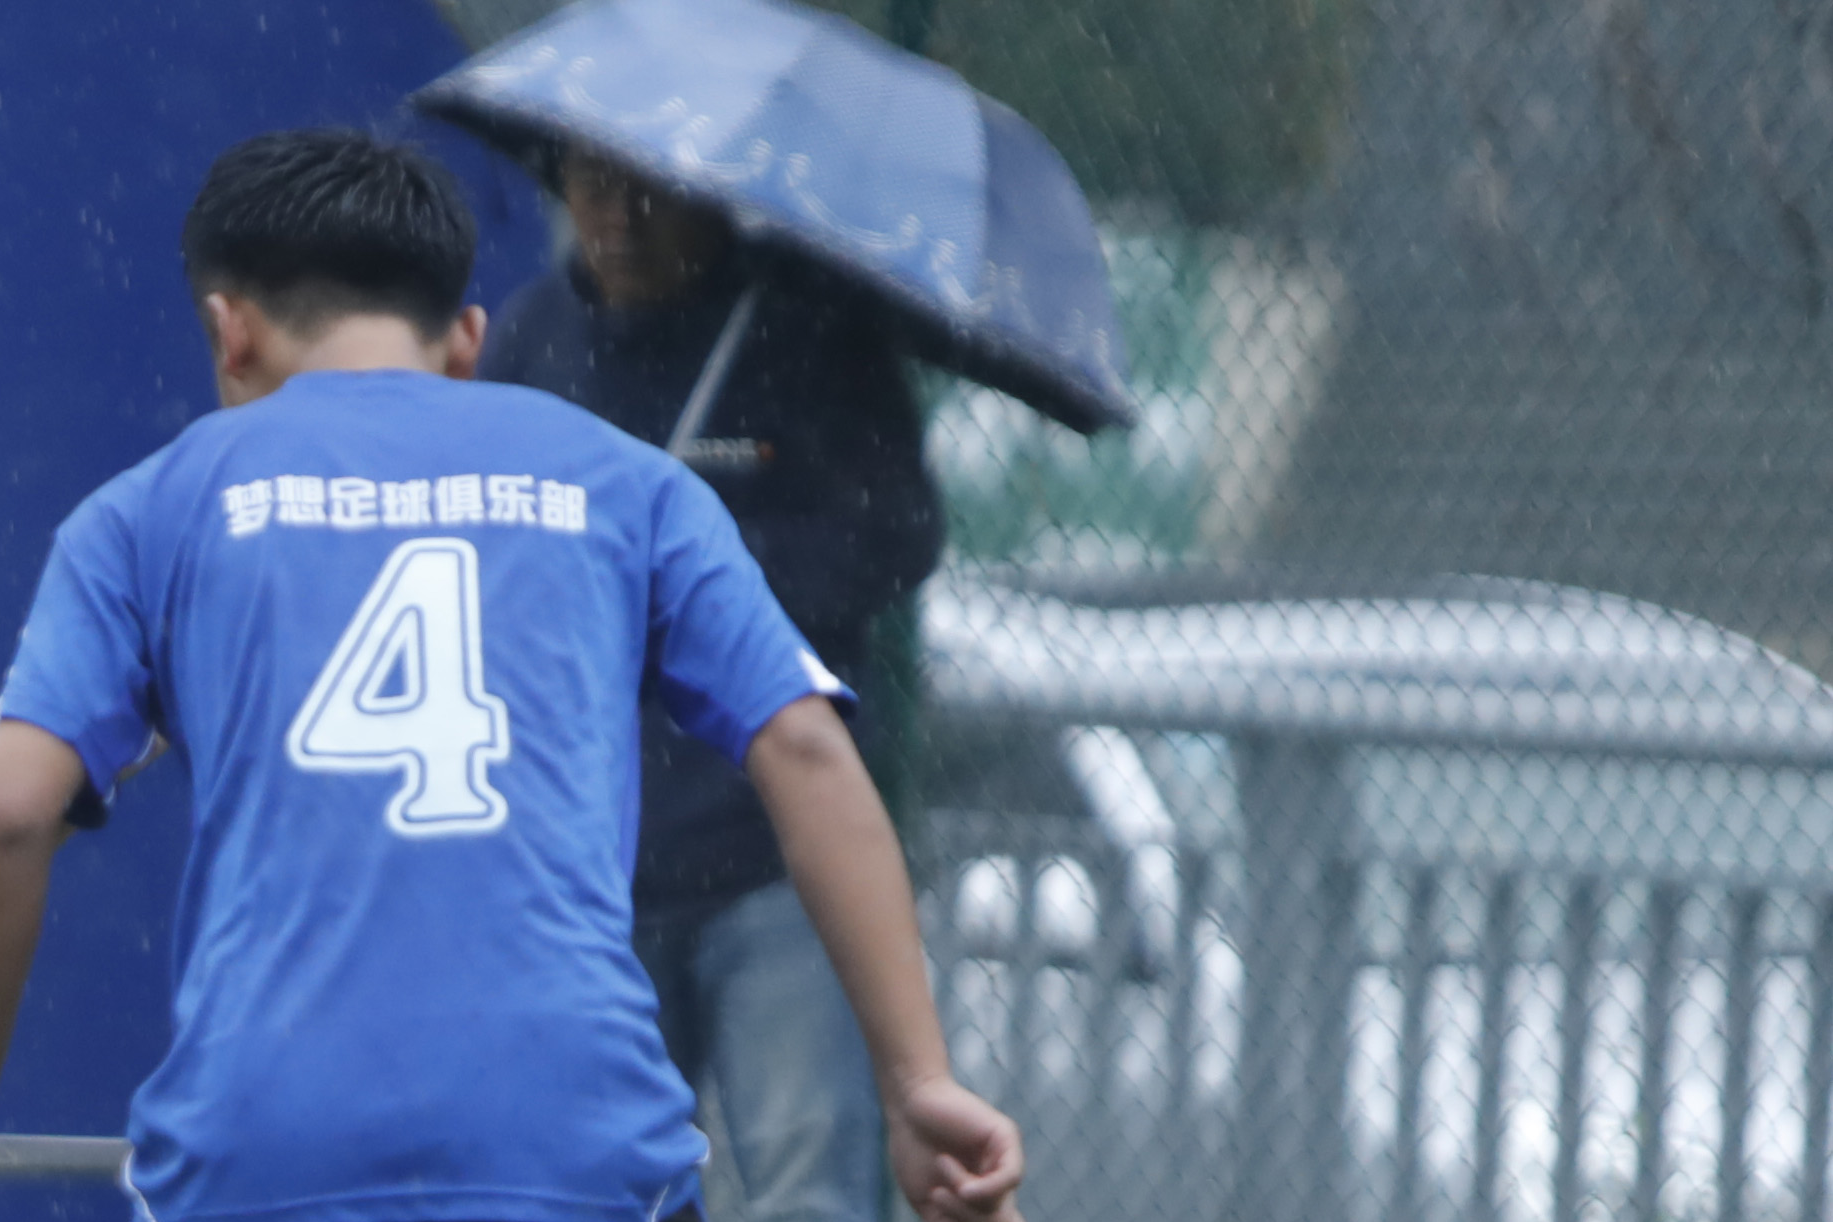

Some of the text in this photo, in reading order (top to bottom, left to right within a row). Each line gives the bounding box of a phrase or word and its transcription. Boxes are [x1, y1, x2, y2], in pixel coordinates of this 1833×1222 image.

[223, 474, 588, 536] 梦想足球俱乐部
[286, 536, 510, 838] 4
